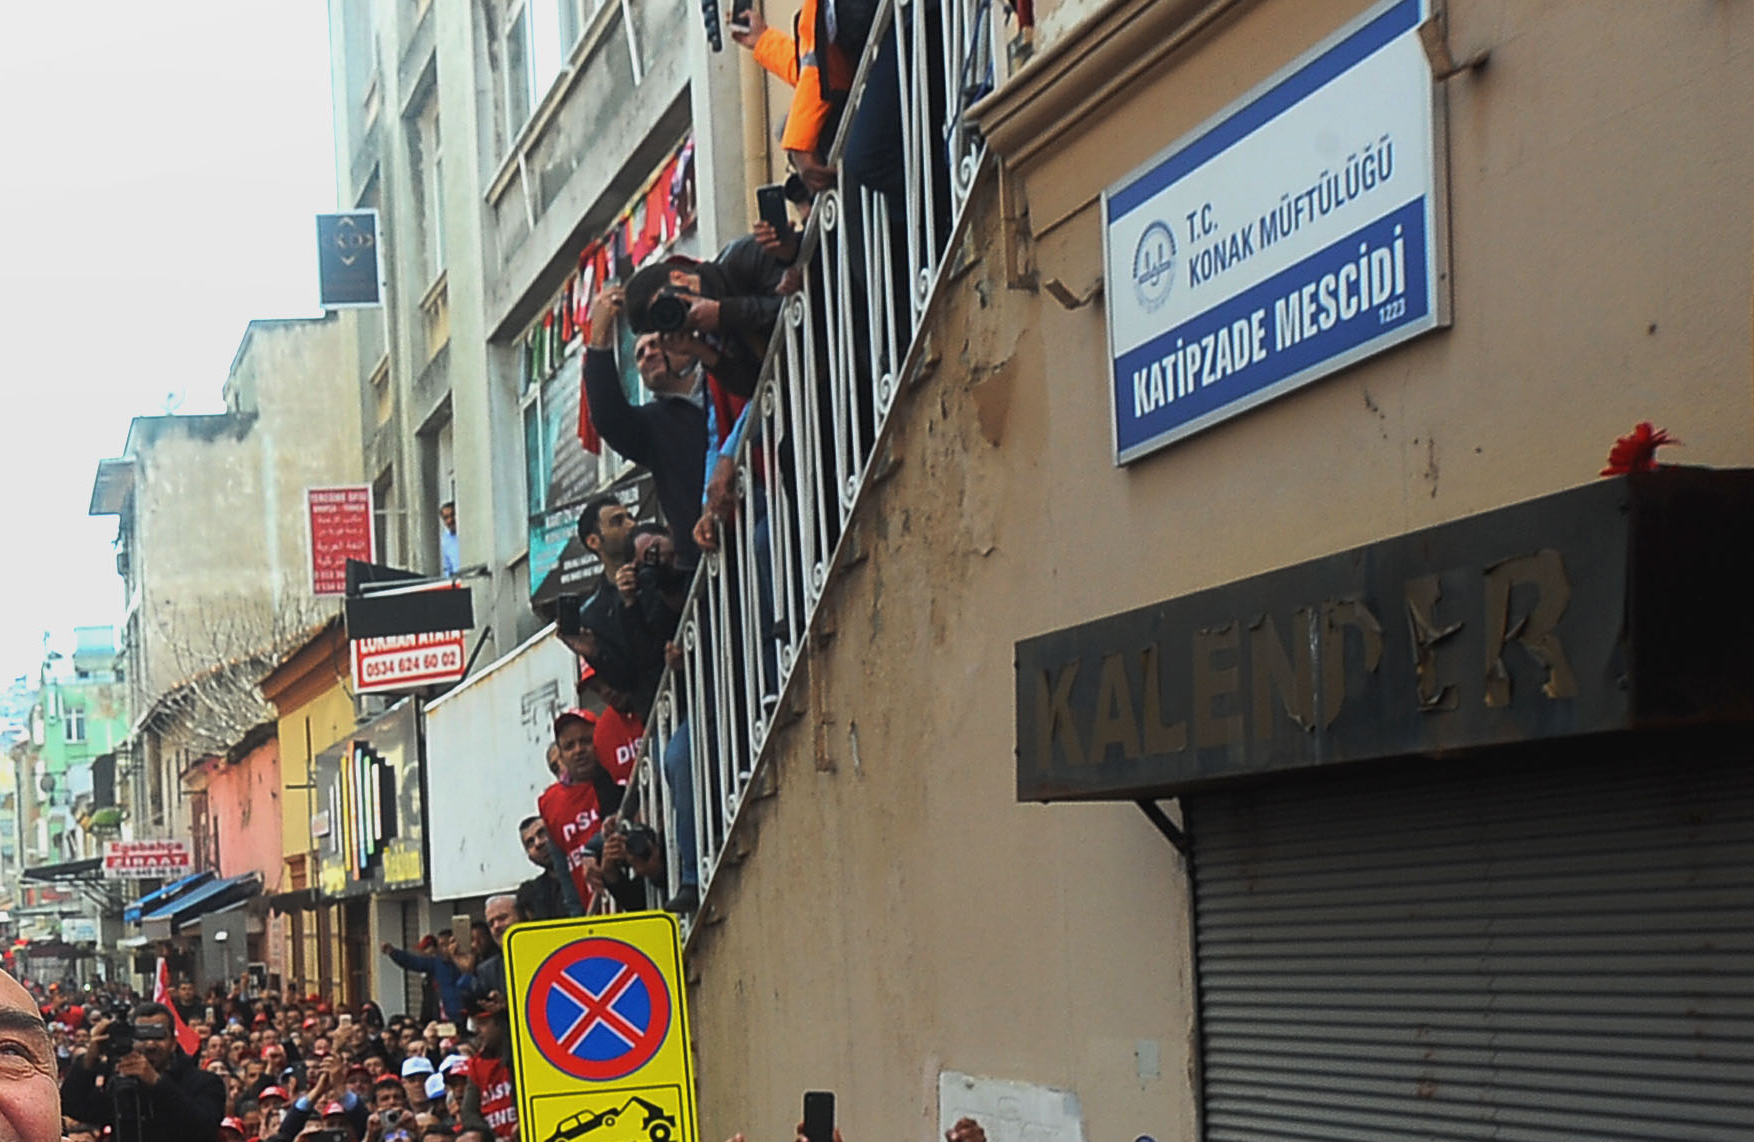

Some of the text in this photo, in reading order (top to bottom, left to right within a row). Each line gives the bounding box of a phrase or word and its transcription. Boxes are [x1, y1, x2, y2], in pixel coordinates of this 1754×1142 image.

[1186, 203, 1218, 243] T.C.
[1188, 224, 1255, 288] KONAK
[1259, 134, 1393, 250] MÜFTÜLÜĞÜ
[1133, 308, 1267, 418] KATİPZADE
[1275, 224, 1405, 351] MESCİDİ
[1379, 299, 1406, 325] 1223
[398, 656, 420, 673] 624
[441, 650, 457, 667] 02
